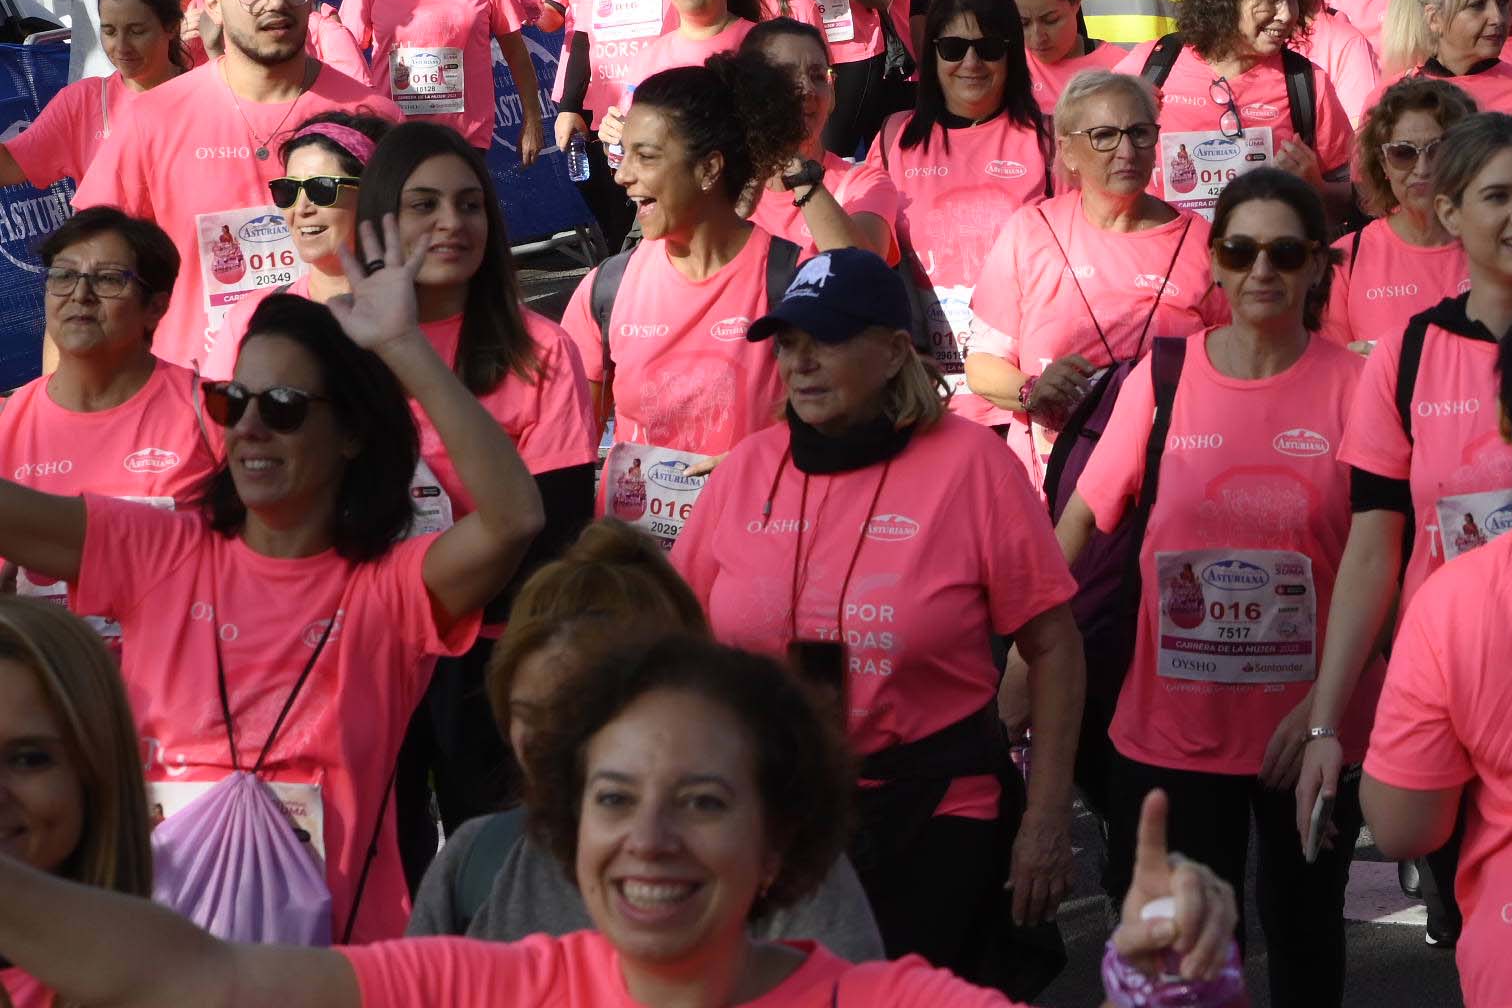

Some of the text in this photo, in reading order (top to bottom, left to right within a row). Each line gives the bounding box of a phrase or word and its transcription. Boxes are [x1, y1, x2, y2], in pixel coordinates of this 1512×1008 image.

[412, 73, 438, 83] 016
[1164, 94, 1207, 107] OYSHO
[195, 145, 251, 160] OYSHO
[1196, 148, 1238, 158] ASTURIANA
[904, 165, 949, 179] OYSHO
[1200, 168, 1238, 183] 016
[249, 249, 295, 271] 016
[255, 271, 292, 286] 20349
[1366, 283, 1418, 301] OYSHO
[620, 322, 670, 338] OYSHO
[1417, 398, 1480, 418] OYSHO
[1276, 437, 1327, 451] ASTURIANA
[650, 468, 702, 487] ASTURIANA
[649, 497, 693, 520] 016
[746, 518, 810, 534] OYSHO
[1207, 570, 1265, 584] ASTURIANA
[845, 603, 895, 624] POR
[1209, 601, 1262, 621] 016
[815, 628, 895, 650] TODAS
[1217, 627, 1251, 640] 7517
[1175, 641, 1216, 652] CARRERA
[1217, 643, 1231, 652] DE
[1232, 644, 1244, 653] LA
[849, 657, 894, 678] RAS
[1171, 657, 1217, 673] OYSHO
[1254, 662, 1304, 673] Santander
